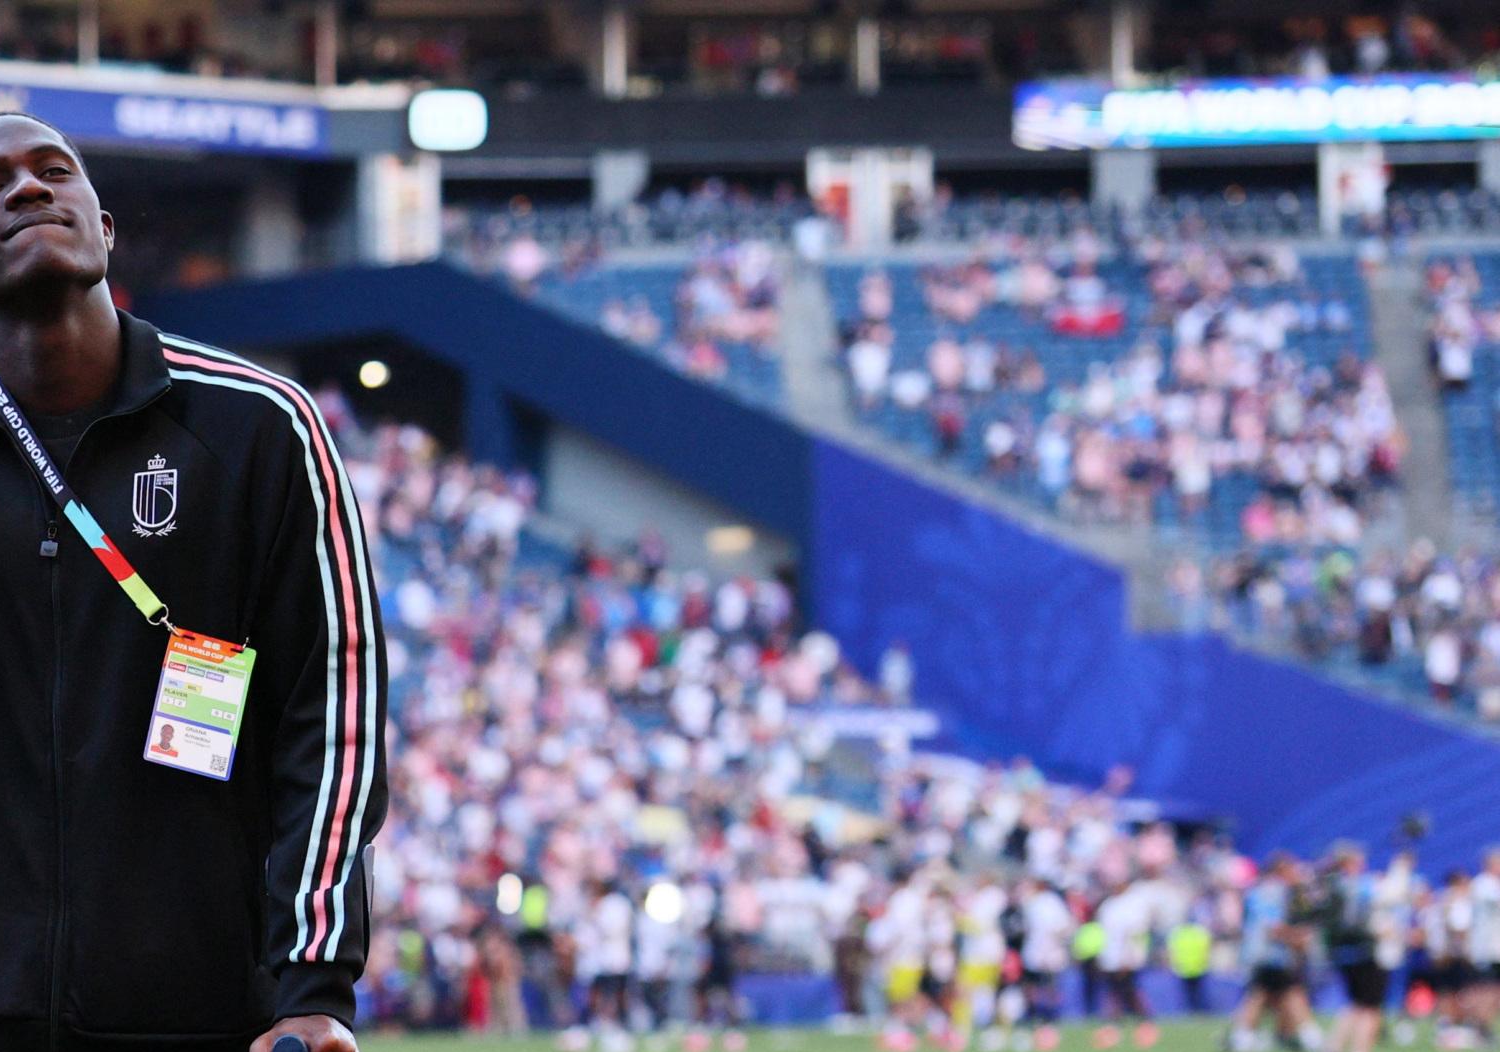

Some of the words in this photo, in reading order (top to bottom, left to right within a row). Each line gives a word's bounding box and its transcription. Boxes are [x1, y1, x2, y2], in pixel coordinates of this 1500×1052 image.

[114, 97, 318, 150] SEATTLE
[2, 405, 23, 430] CUP
[17, 427, 48, 471] WORLD
[43, 465, 64, 494] FIFA
